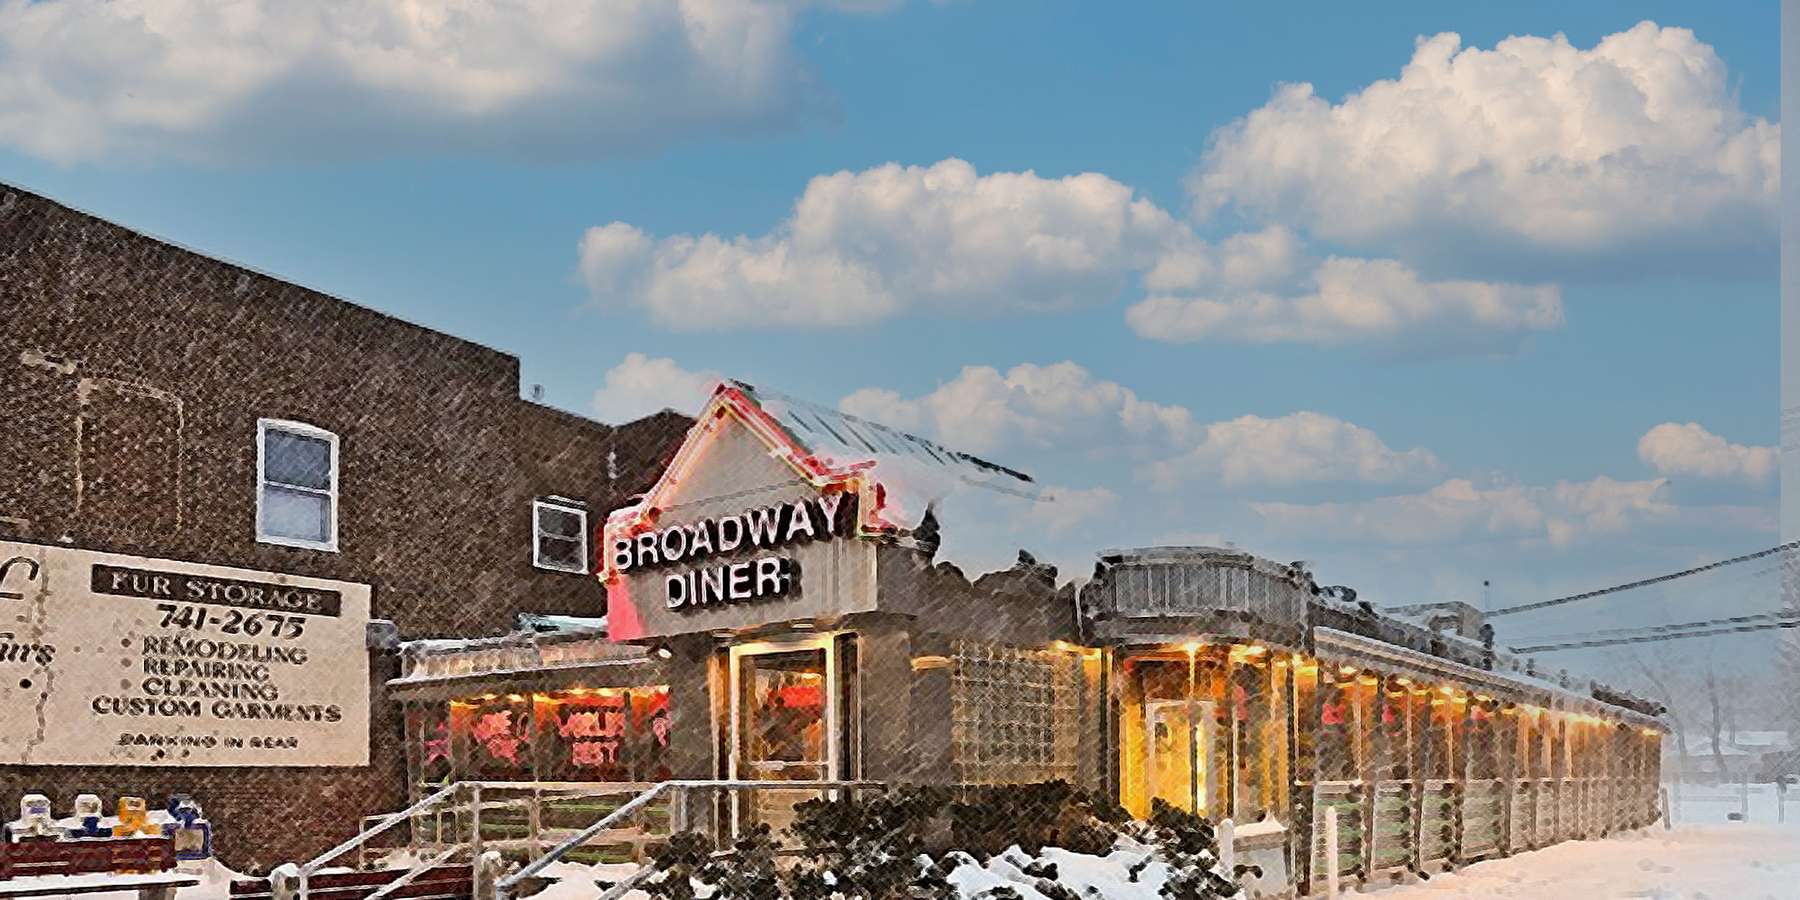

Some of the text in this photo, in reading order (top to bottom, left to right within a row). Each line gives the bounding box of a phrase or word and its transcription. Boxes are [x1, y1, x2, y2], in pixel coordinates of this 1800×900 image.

[614, 491, 843, 571] BROADWAY
[110, 571, 324, 610] FUR STORAGE
[665, 556, 782, 609] DINER
[156, 603, 306, 640] 741-2675
[141, 634, 309, 665] REMODELING
[142, 656, 270, 682] REPAIRING
[141, 677, 279, 702] CLEANING
[91, 694, 344, 723] CUSTOM GARMENTS
[117, 733, 299, 750] PARKING IN REAR
